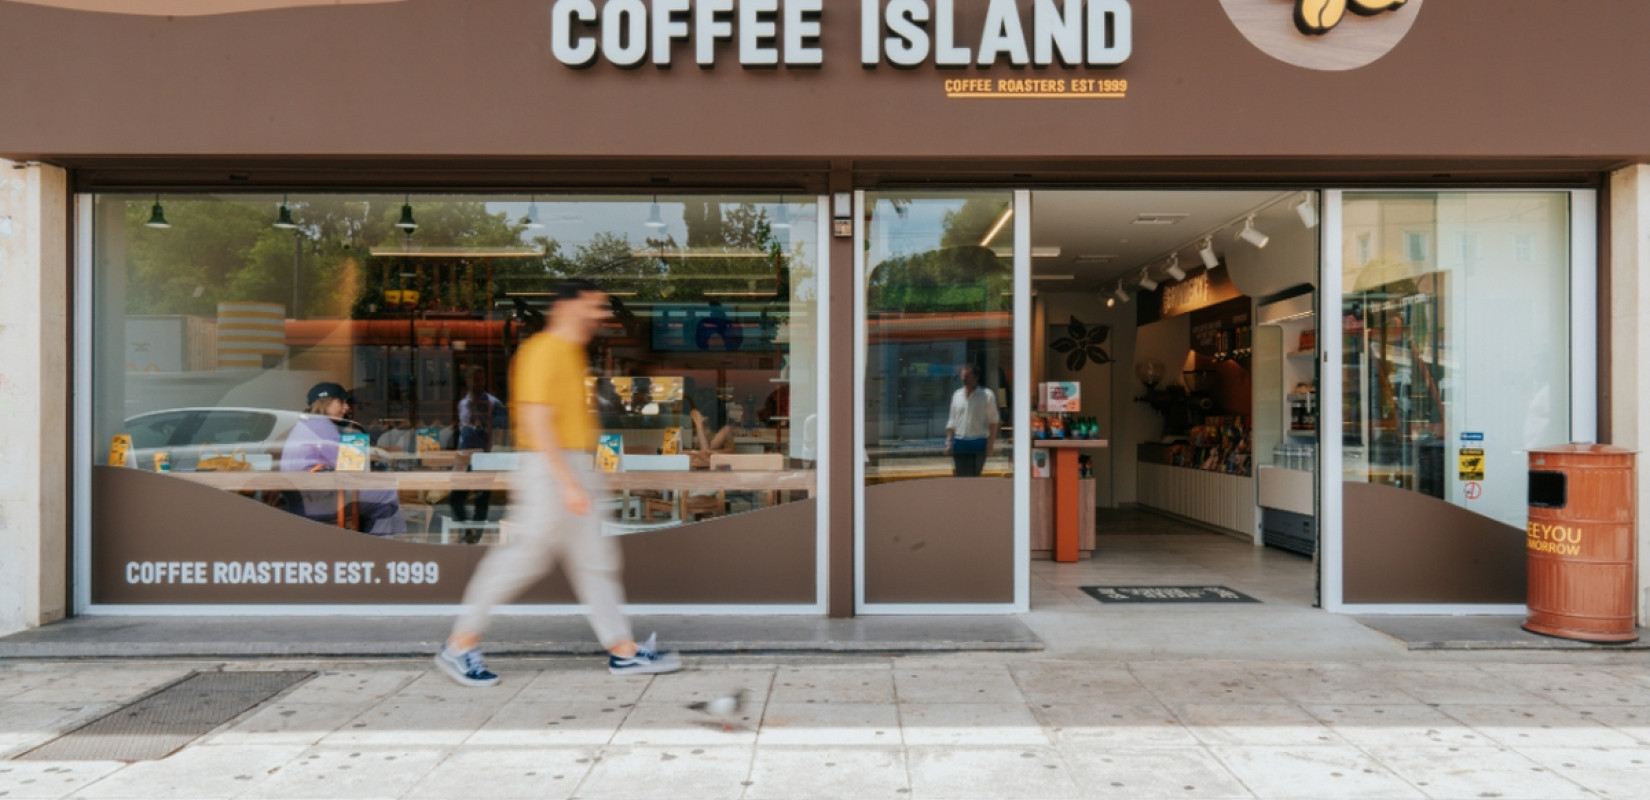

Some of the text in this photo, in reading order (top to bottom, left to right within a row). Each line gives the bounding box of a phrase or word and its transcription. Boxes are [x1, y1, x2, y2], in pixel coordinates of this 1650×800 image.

[550, 0, 1133, 66] COFFEE ISLAND
[944, 79, 1128, 92] COFFEE ROASTERS EST 1999
[1527, 521, 1582, 544] EE YOU
[1527, 539, 1581, 556] MORROW
[126, 561, 439, 584] COFFEE ROASTERS EST. 1999
